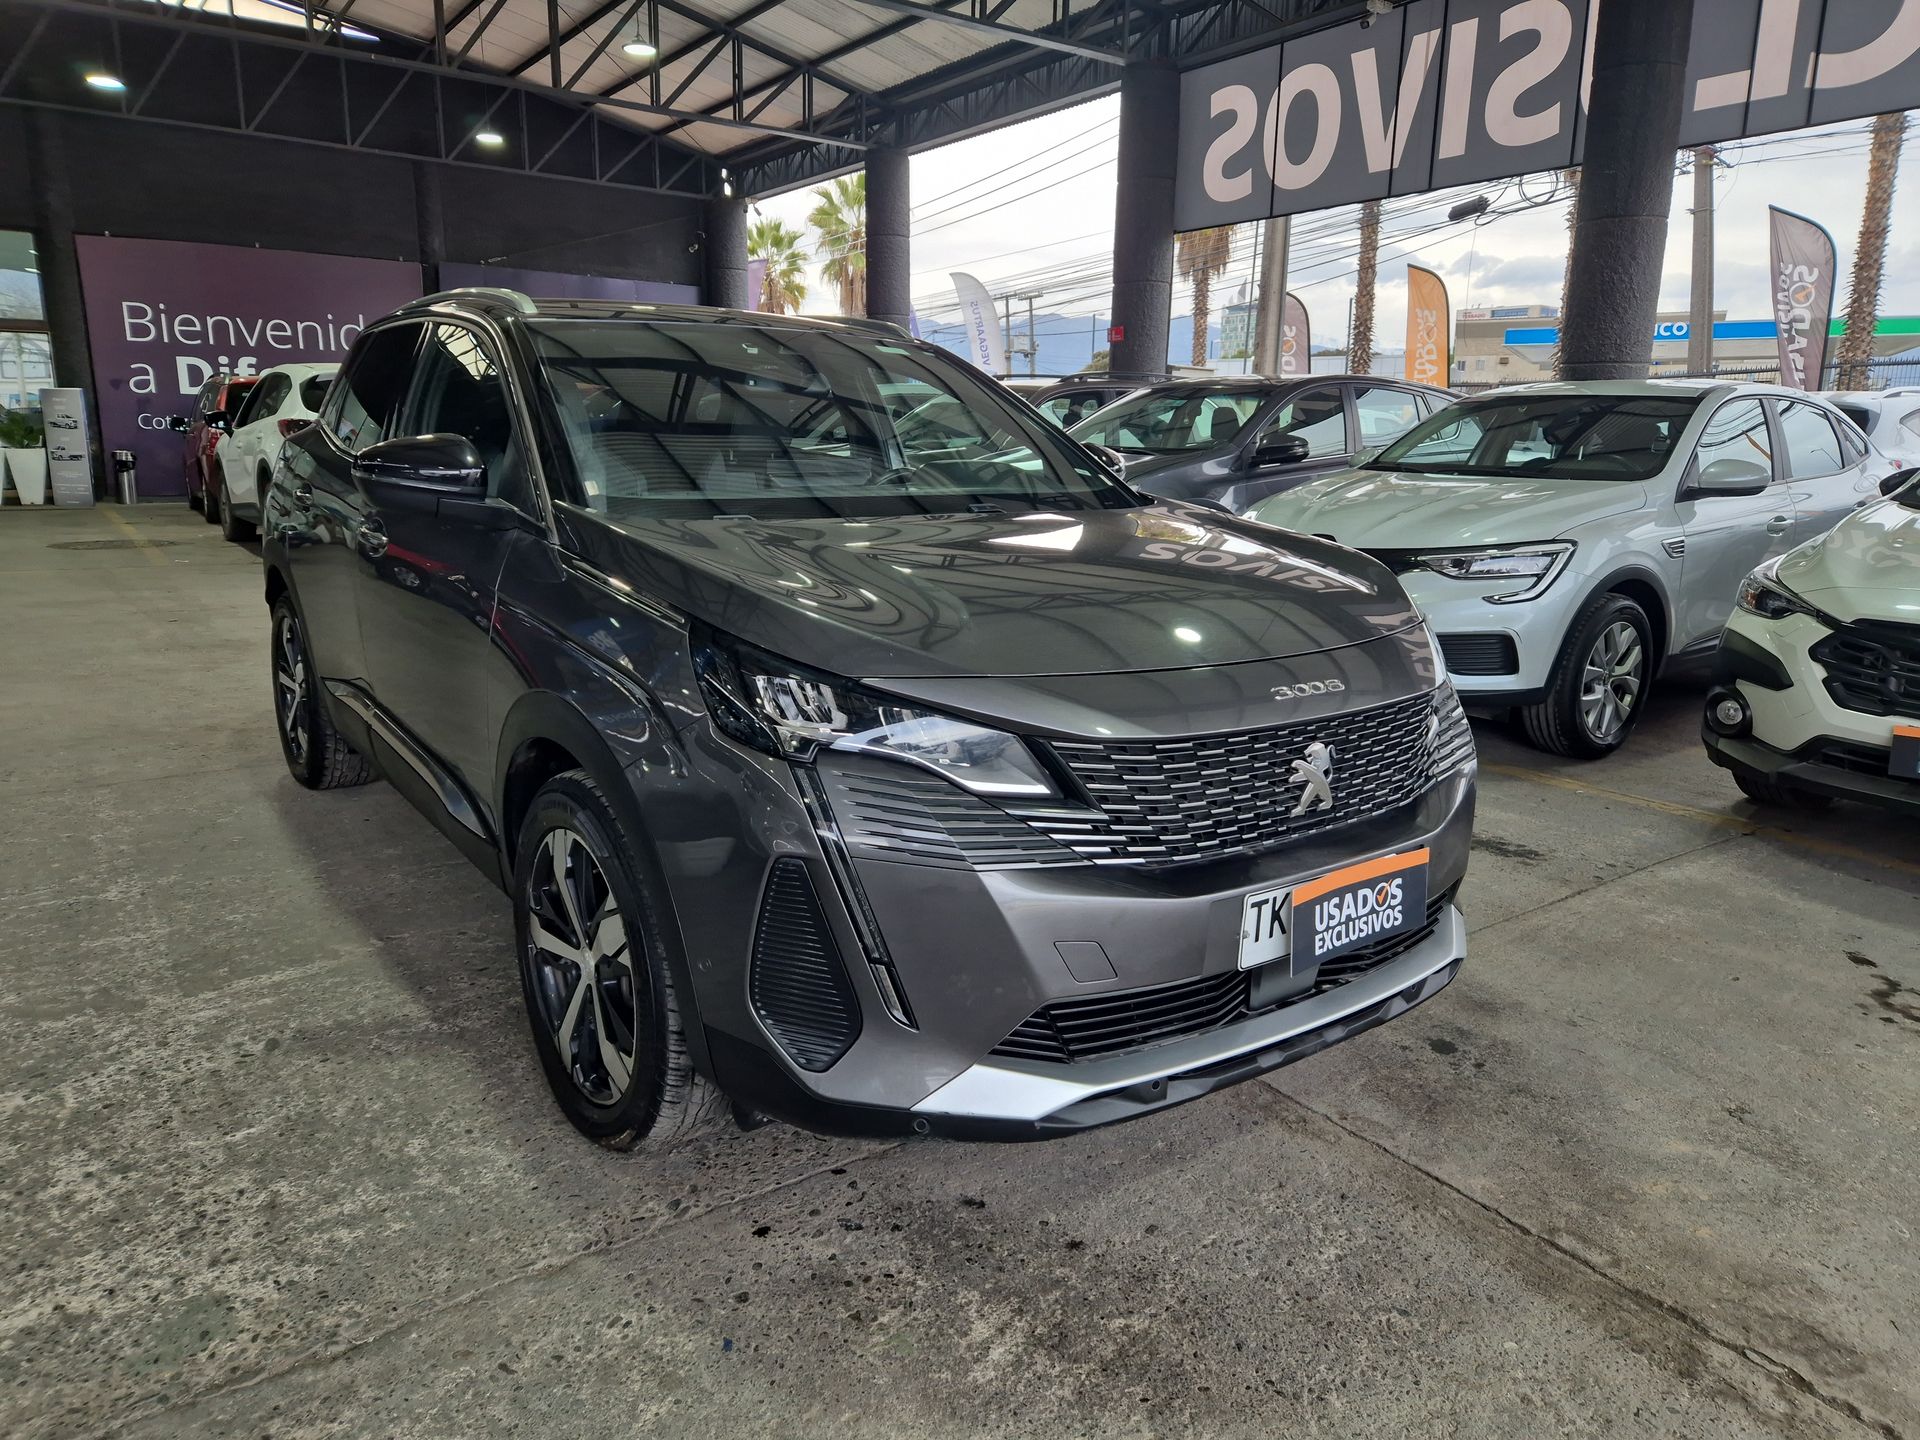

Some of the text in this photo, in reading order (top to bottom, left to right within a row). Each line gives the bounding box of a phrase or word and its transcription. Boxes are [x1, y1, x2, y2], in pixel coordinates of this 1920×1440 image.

[128, 363, 157, 394] a
[1314, 877, 1403, 933] USADOS
[1314, 905, 1403, 956] EXCLUSIVOS
